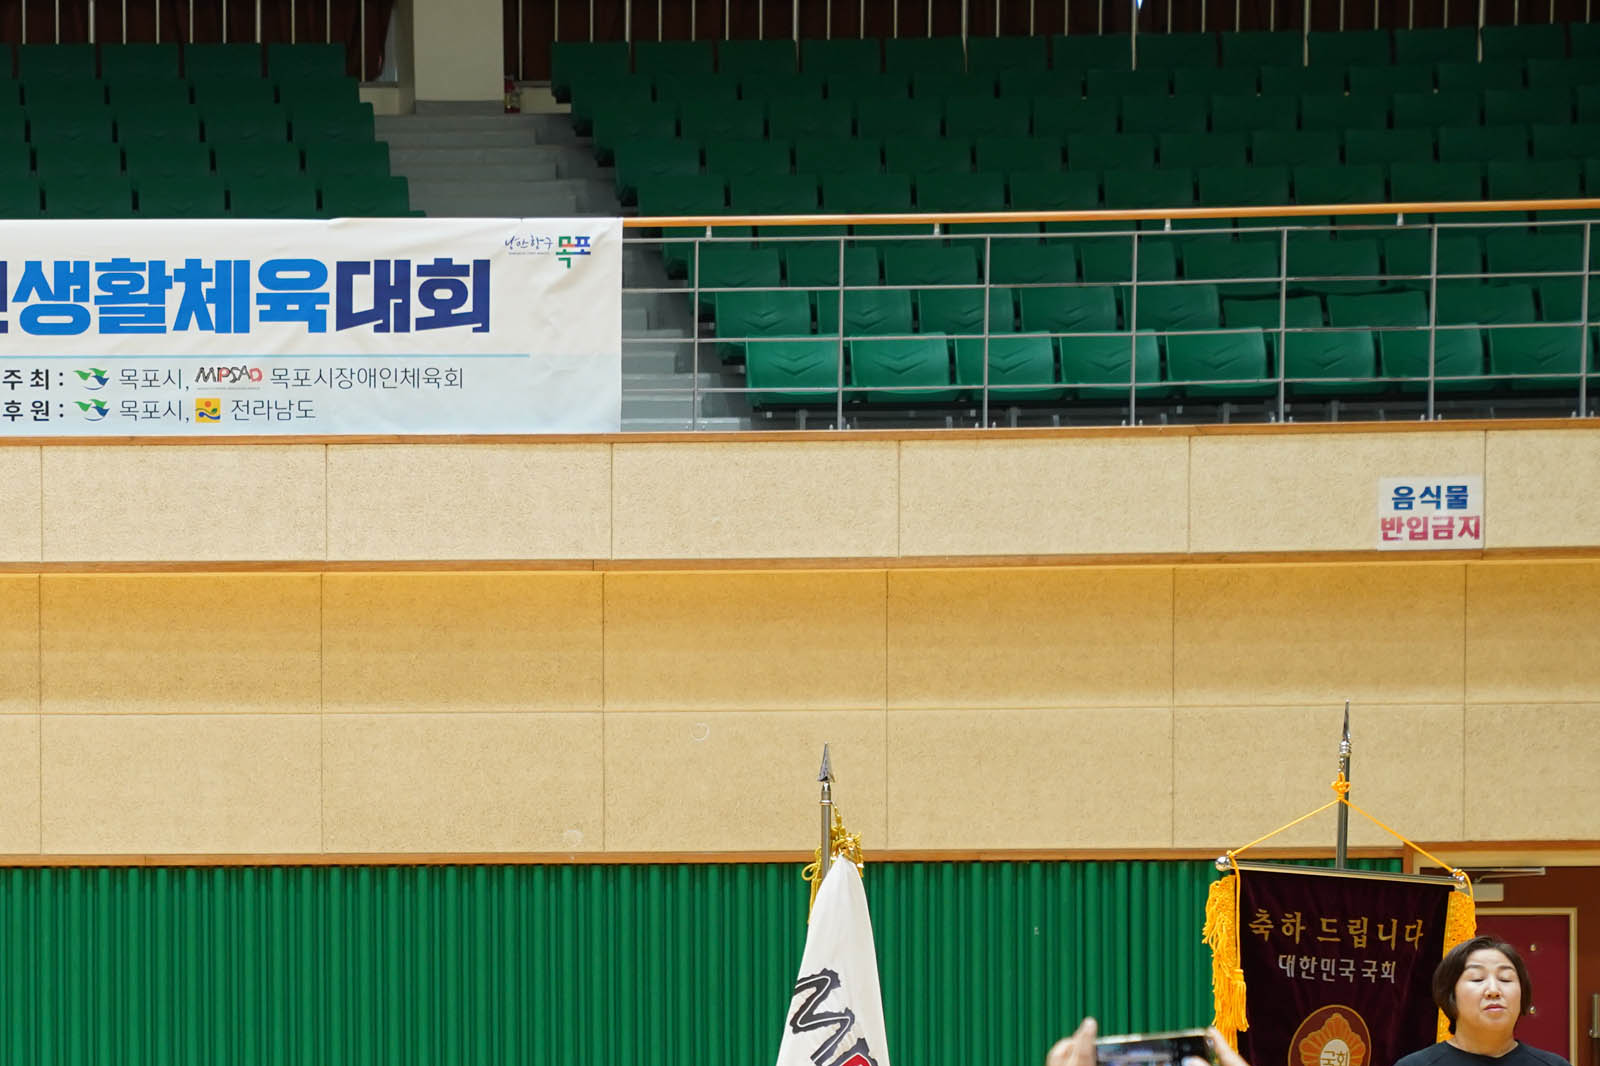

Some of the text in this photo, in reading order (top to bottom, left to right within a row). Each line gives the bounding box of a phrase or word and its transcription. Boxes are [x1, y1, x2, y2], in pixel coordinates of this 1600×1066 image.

[556, 236, 591, 269] 목포
[119, 368, 189, 391] 목포시,
[270, 367, 463, 389] 목포시장애인체육회
[119, 399, 189, 423] 목포시,
[231, 399, 316, 421] 전라남도
[1392, 485, 1468, 510] 음식물
[1380, 516, 1481, 541] 반입금지
[1249, 908, 1424, 950] 축하 드립니다
